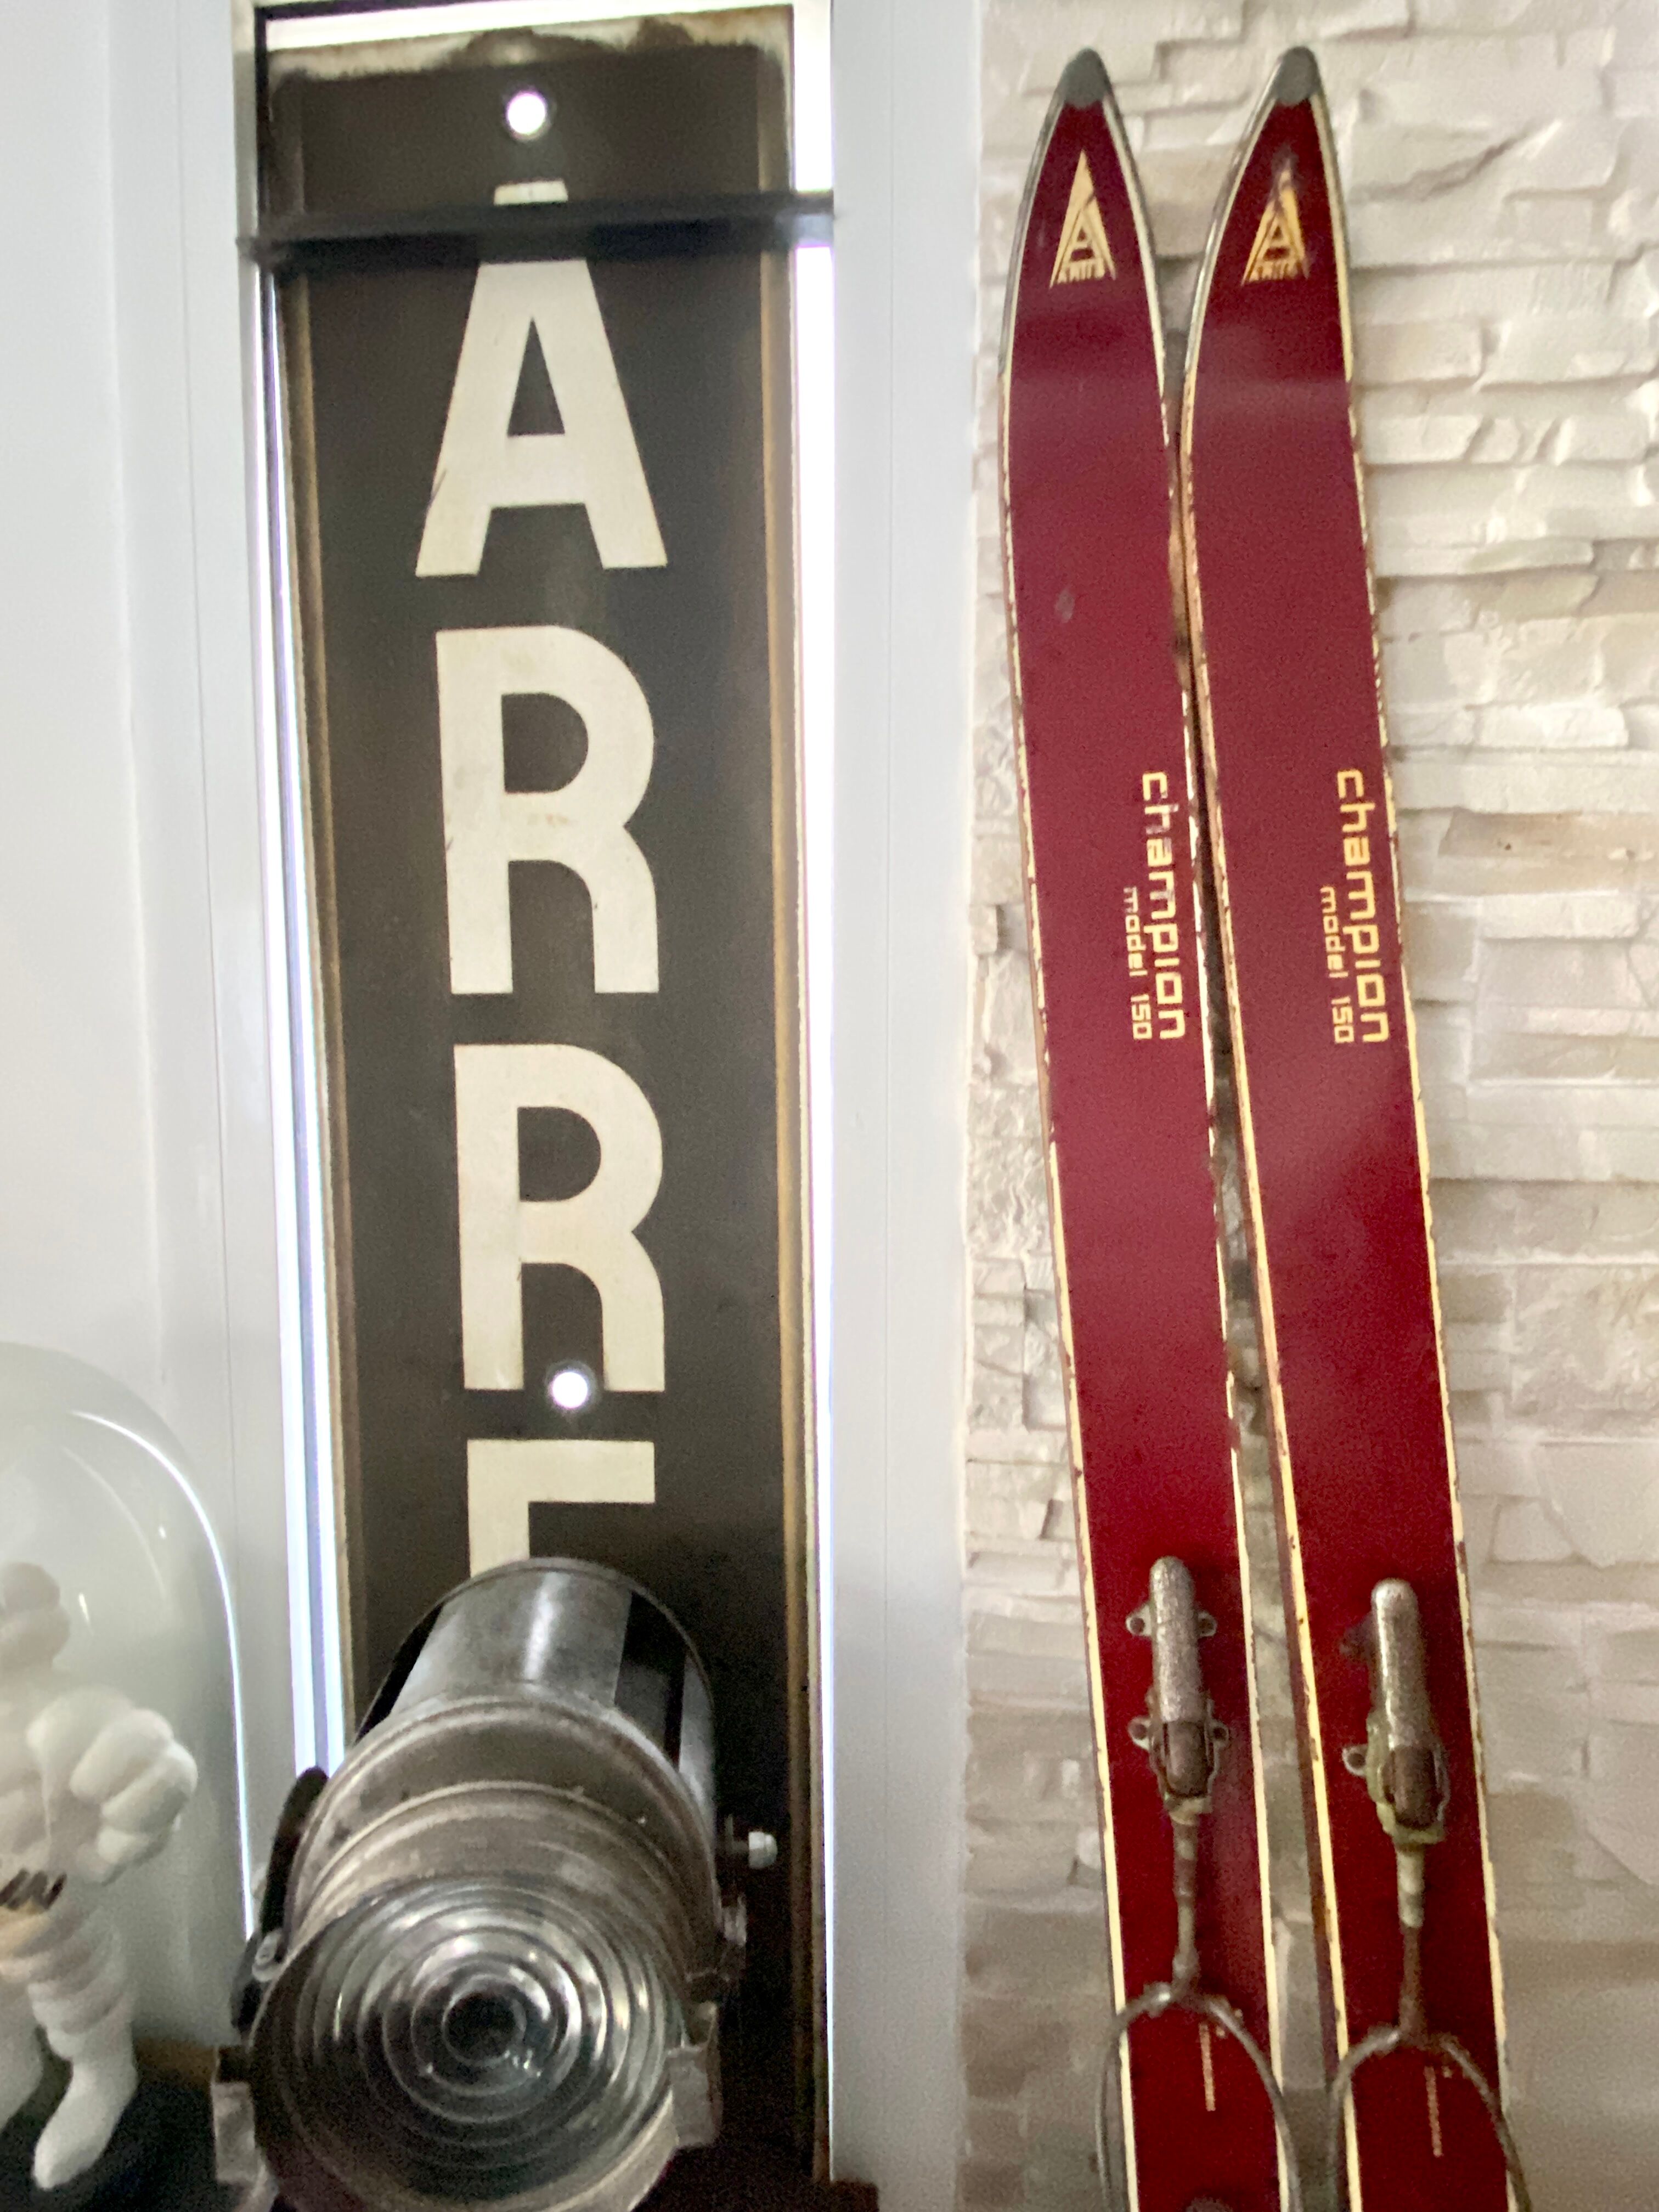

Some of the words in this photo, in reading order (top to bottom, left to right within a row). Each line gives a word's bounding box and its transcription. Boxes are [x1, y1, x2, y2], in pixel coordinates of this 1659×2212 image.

[1123, 886, 1148, 977] model
[1142, 771, 1186, 1040] champion
[1319, 885, 1349, 979] model
[1336, 769, 1390, 1043] champion
[1130, 994, 1153, 1040] 150
[1330, 995, 1355, 1044] 150
